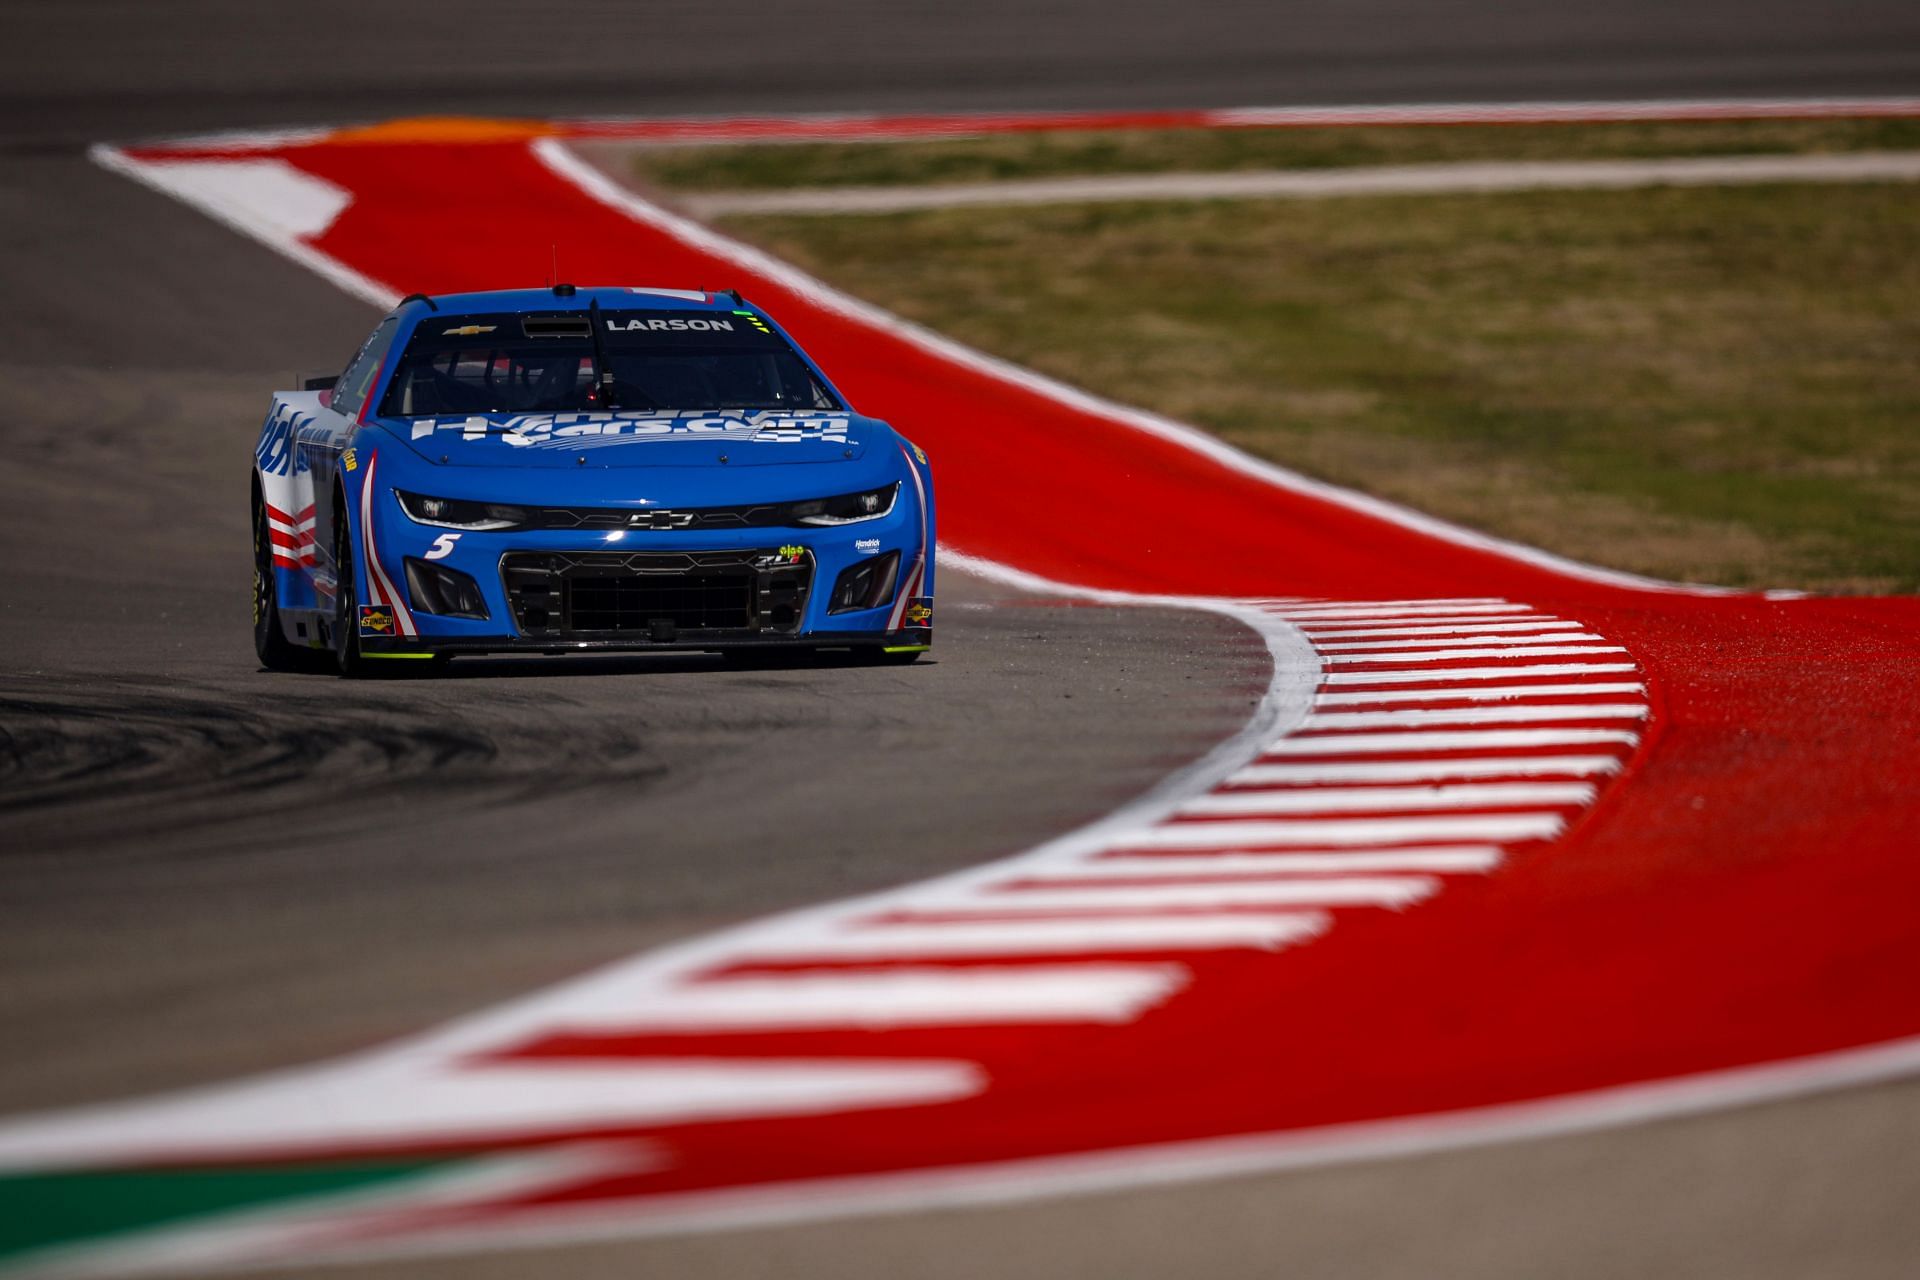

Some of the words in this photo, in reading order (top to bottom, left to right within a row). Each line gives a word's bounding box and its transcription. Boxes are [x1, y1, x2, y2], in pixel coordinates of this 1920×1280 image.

[608, 319, 734, 332] LARSON
[424, 533, 462, 560] 5
[855, 538, 881, 550] Hendrick
[363, 617, 391, 626] SUNOCO
